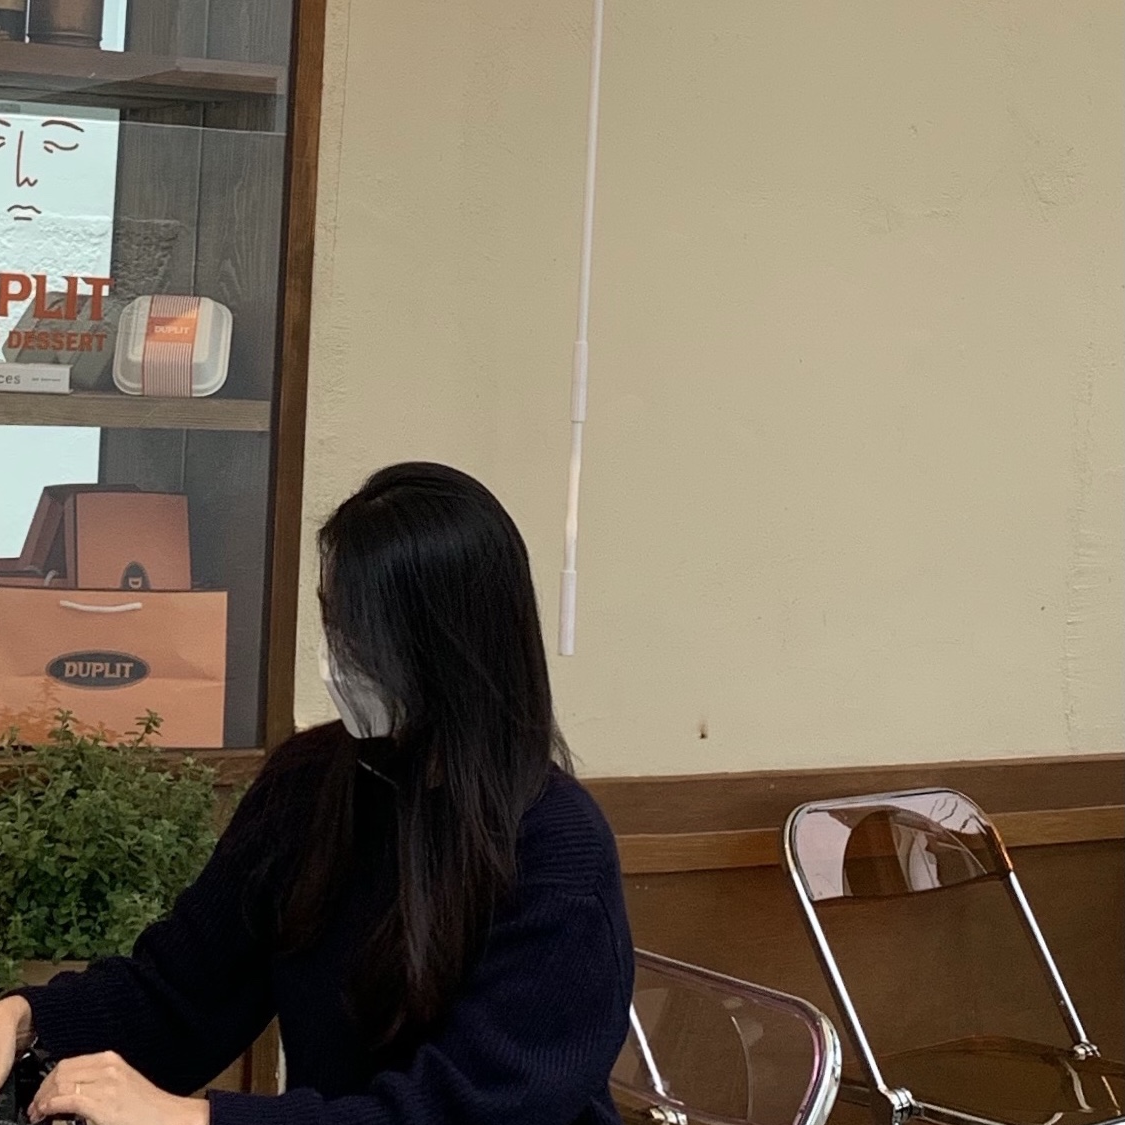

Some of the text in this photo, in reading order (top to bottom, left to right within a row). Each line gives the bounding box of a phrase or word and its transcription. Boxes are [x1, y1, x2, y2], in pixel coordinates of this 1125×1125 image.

[154, 325, 190, 335] DUPLIT
[7, 330, 107, 352] DESSERT
[64, 661, 134, 678] DUPLIT
